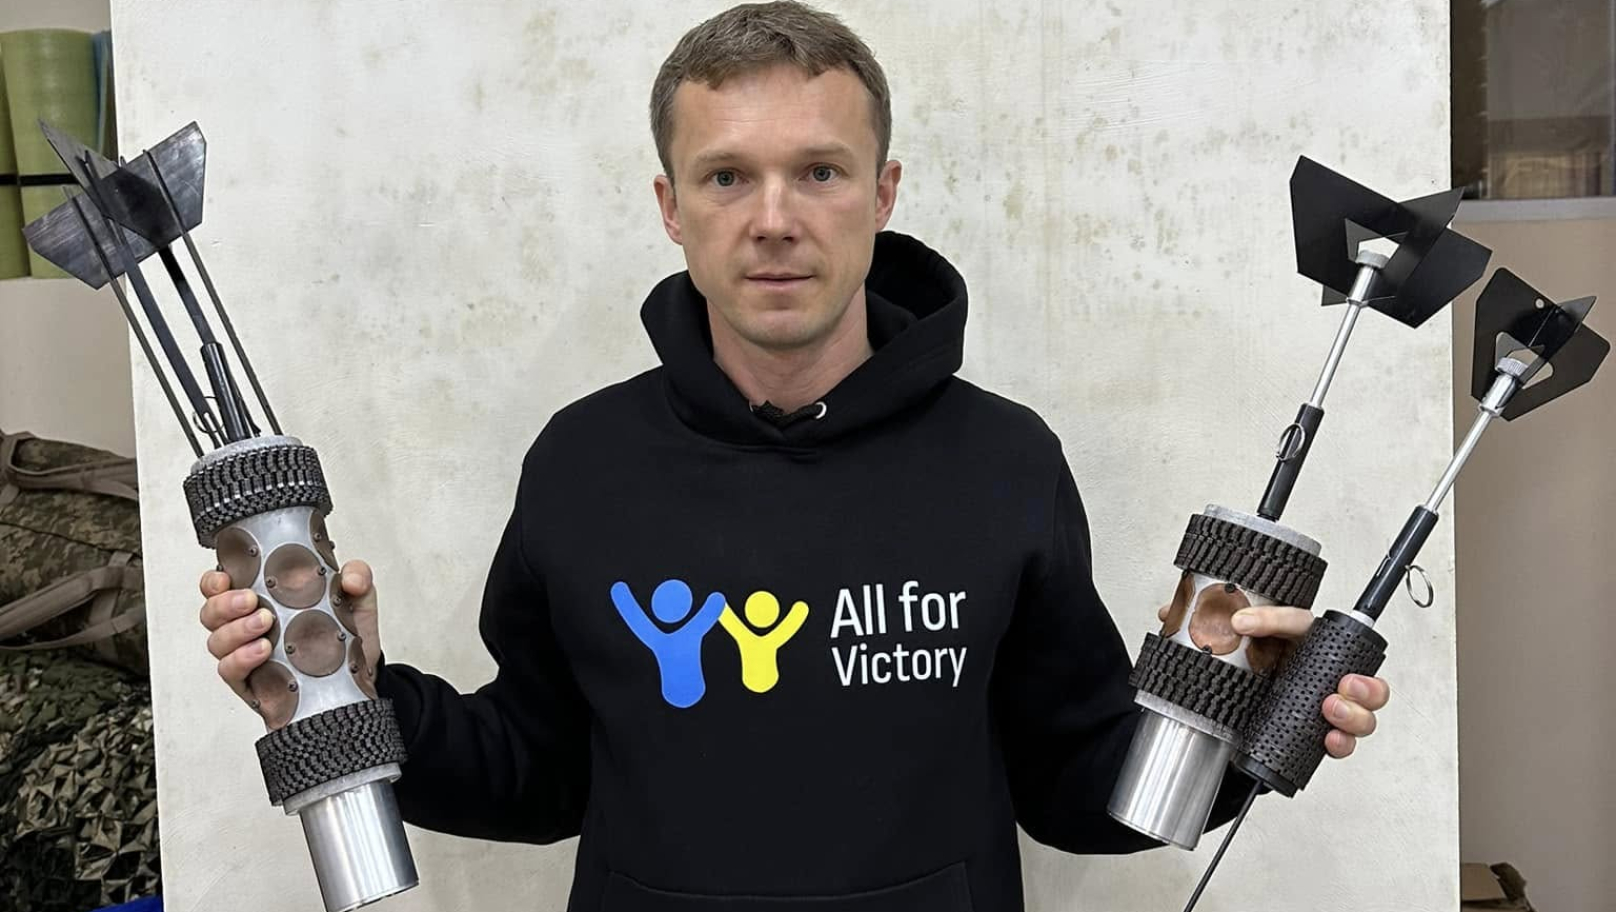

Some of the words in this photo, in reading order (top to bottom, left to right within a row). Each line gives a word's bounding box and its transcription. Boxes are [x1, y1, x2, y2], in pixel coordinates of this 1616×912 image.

[830, 583, 887, 638] All
[898, 580, 966, 633] for
[831, 643, 967, 688] Victory
